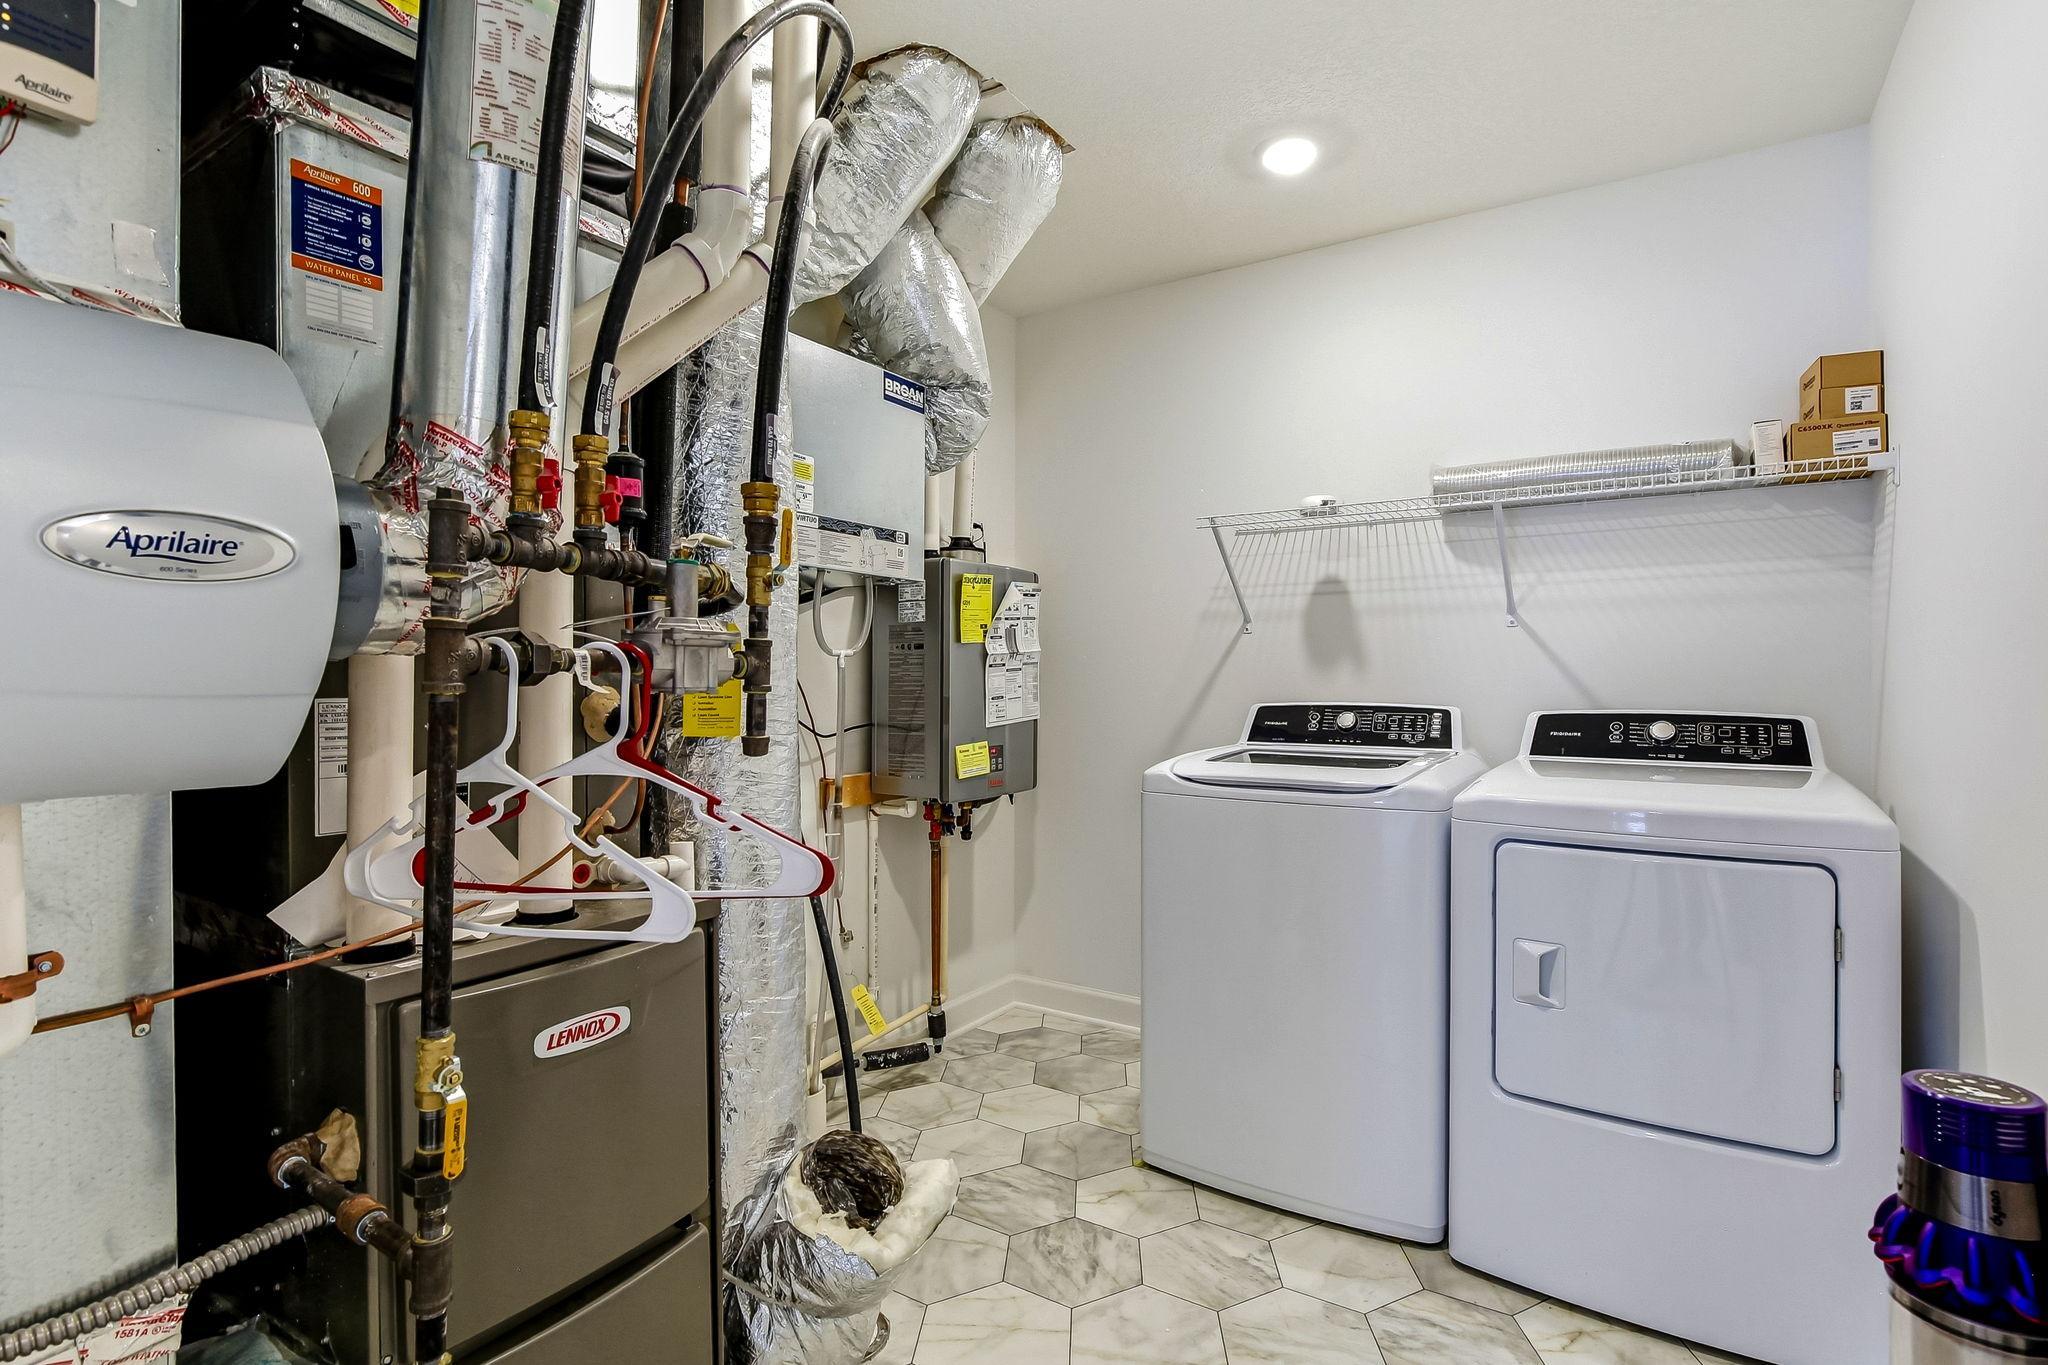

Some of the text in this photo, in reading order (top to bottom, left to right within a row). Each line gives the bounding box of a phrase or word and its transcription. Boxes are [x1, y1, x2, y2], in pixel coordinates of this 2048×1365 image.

[15, 74, 72, 103] Aprilaire
[303, 165, 341, 184] Aprilaire
[353, 182, 371, 197] 600
[304, 260, 334, 274] WATER
[335, 268, 361, 281] PANEL
[363, 276, 372, 285] 35
[543, 371, 549, 380] TO
[543, 381, 551, 397] GAS
[885, 378, 924, 404] BROAN
[606, 400, 612, 410] TO
[1797, 423, 1833, 433] C6500XK
[105, 525, 239, 558] Aprilaire
[175, 566, 198, 574] Series
[546, 1016, 608, 1051] LENNOX
[1988, 1190, 2002, 1228] dyson
[114, 1327, 149, 1339] 1581A
